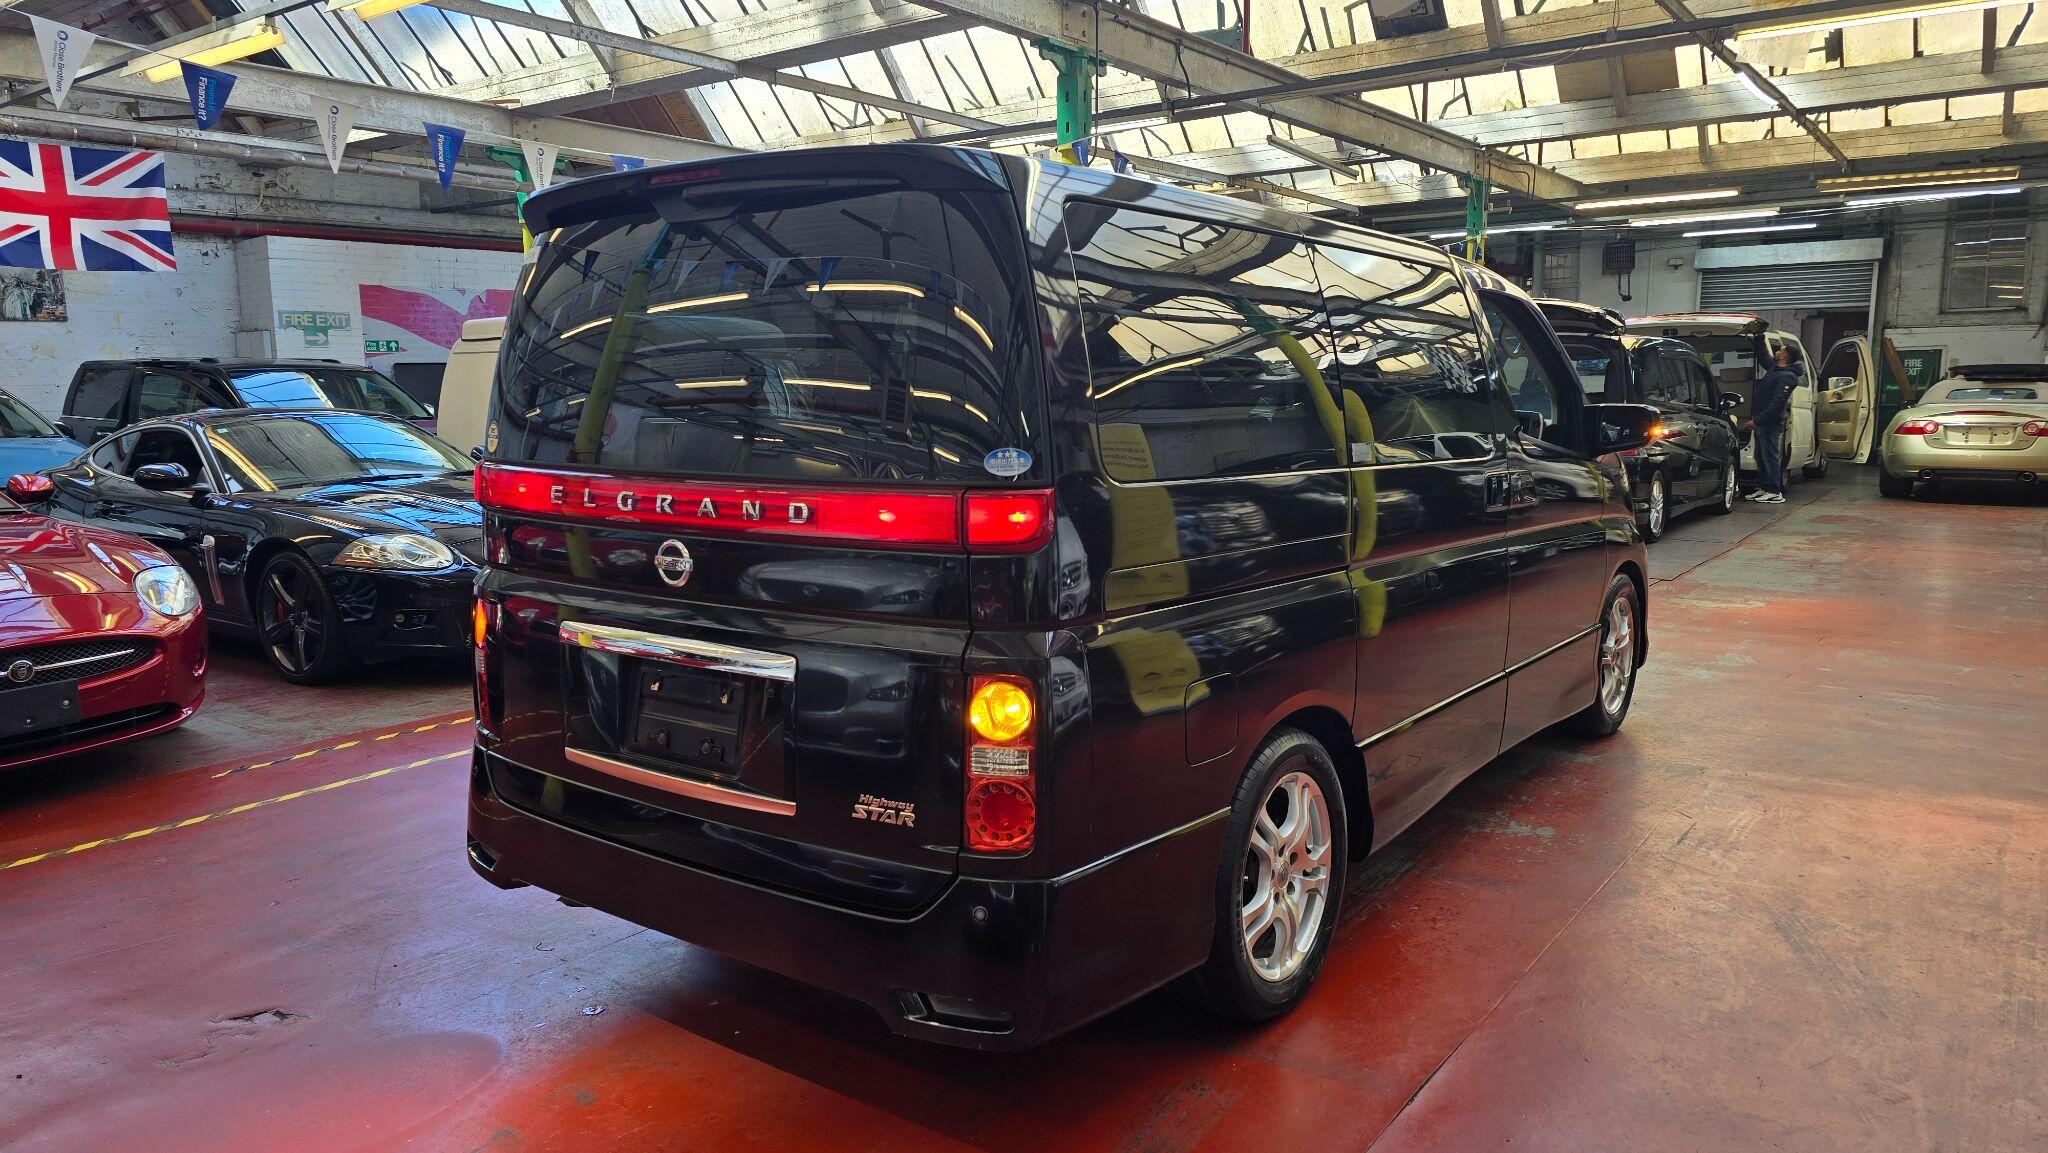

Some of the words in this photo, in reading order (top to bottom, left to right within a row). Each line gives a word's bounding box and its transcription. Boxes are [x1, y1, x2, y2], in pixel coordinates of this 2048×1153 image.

[58, 42, 67, 62] Close
[56, 62, 65, 93] Brothers
[198, 76, 208, 108] Finance
[198, 110, 207, 121] it?
[282, 312, 314, 326] FIRE
[316, 313, 349, 327] EXIT
[1904, 359, 1922, 367] FIRE
[551, 485, 810, 524] ELGRAND
[656, 557, 690, 570] NISSAN
[859, 793, 915, 812] Highway
[851, 804, 916, 828] STAR
